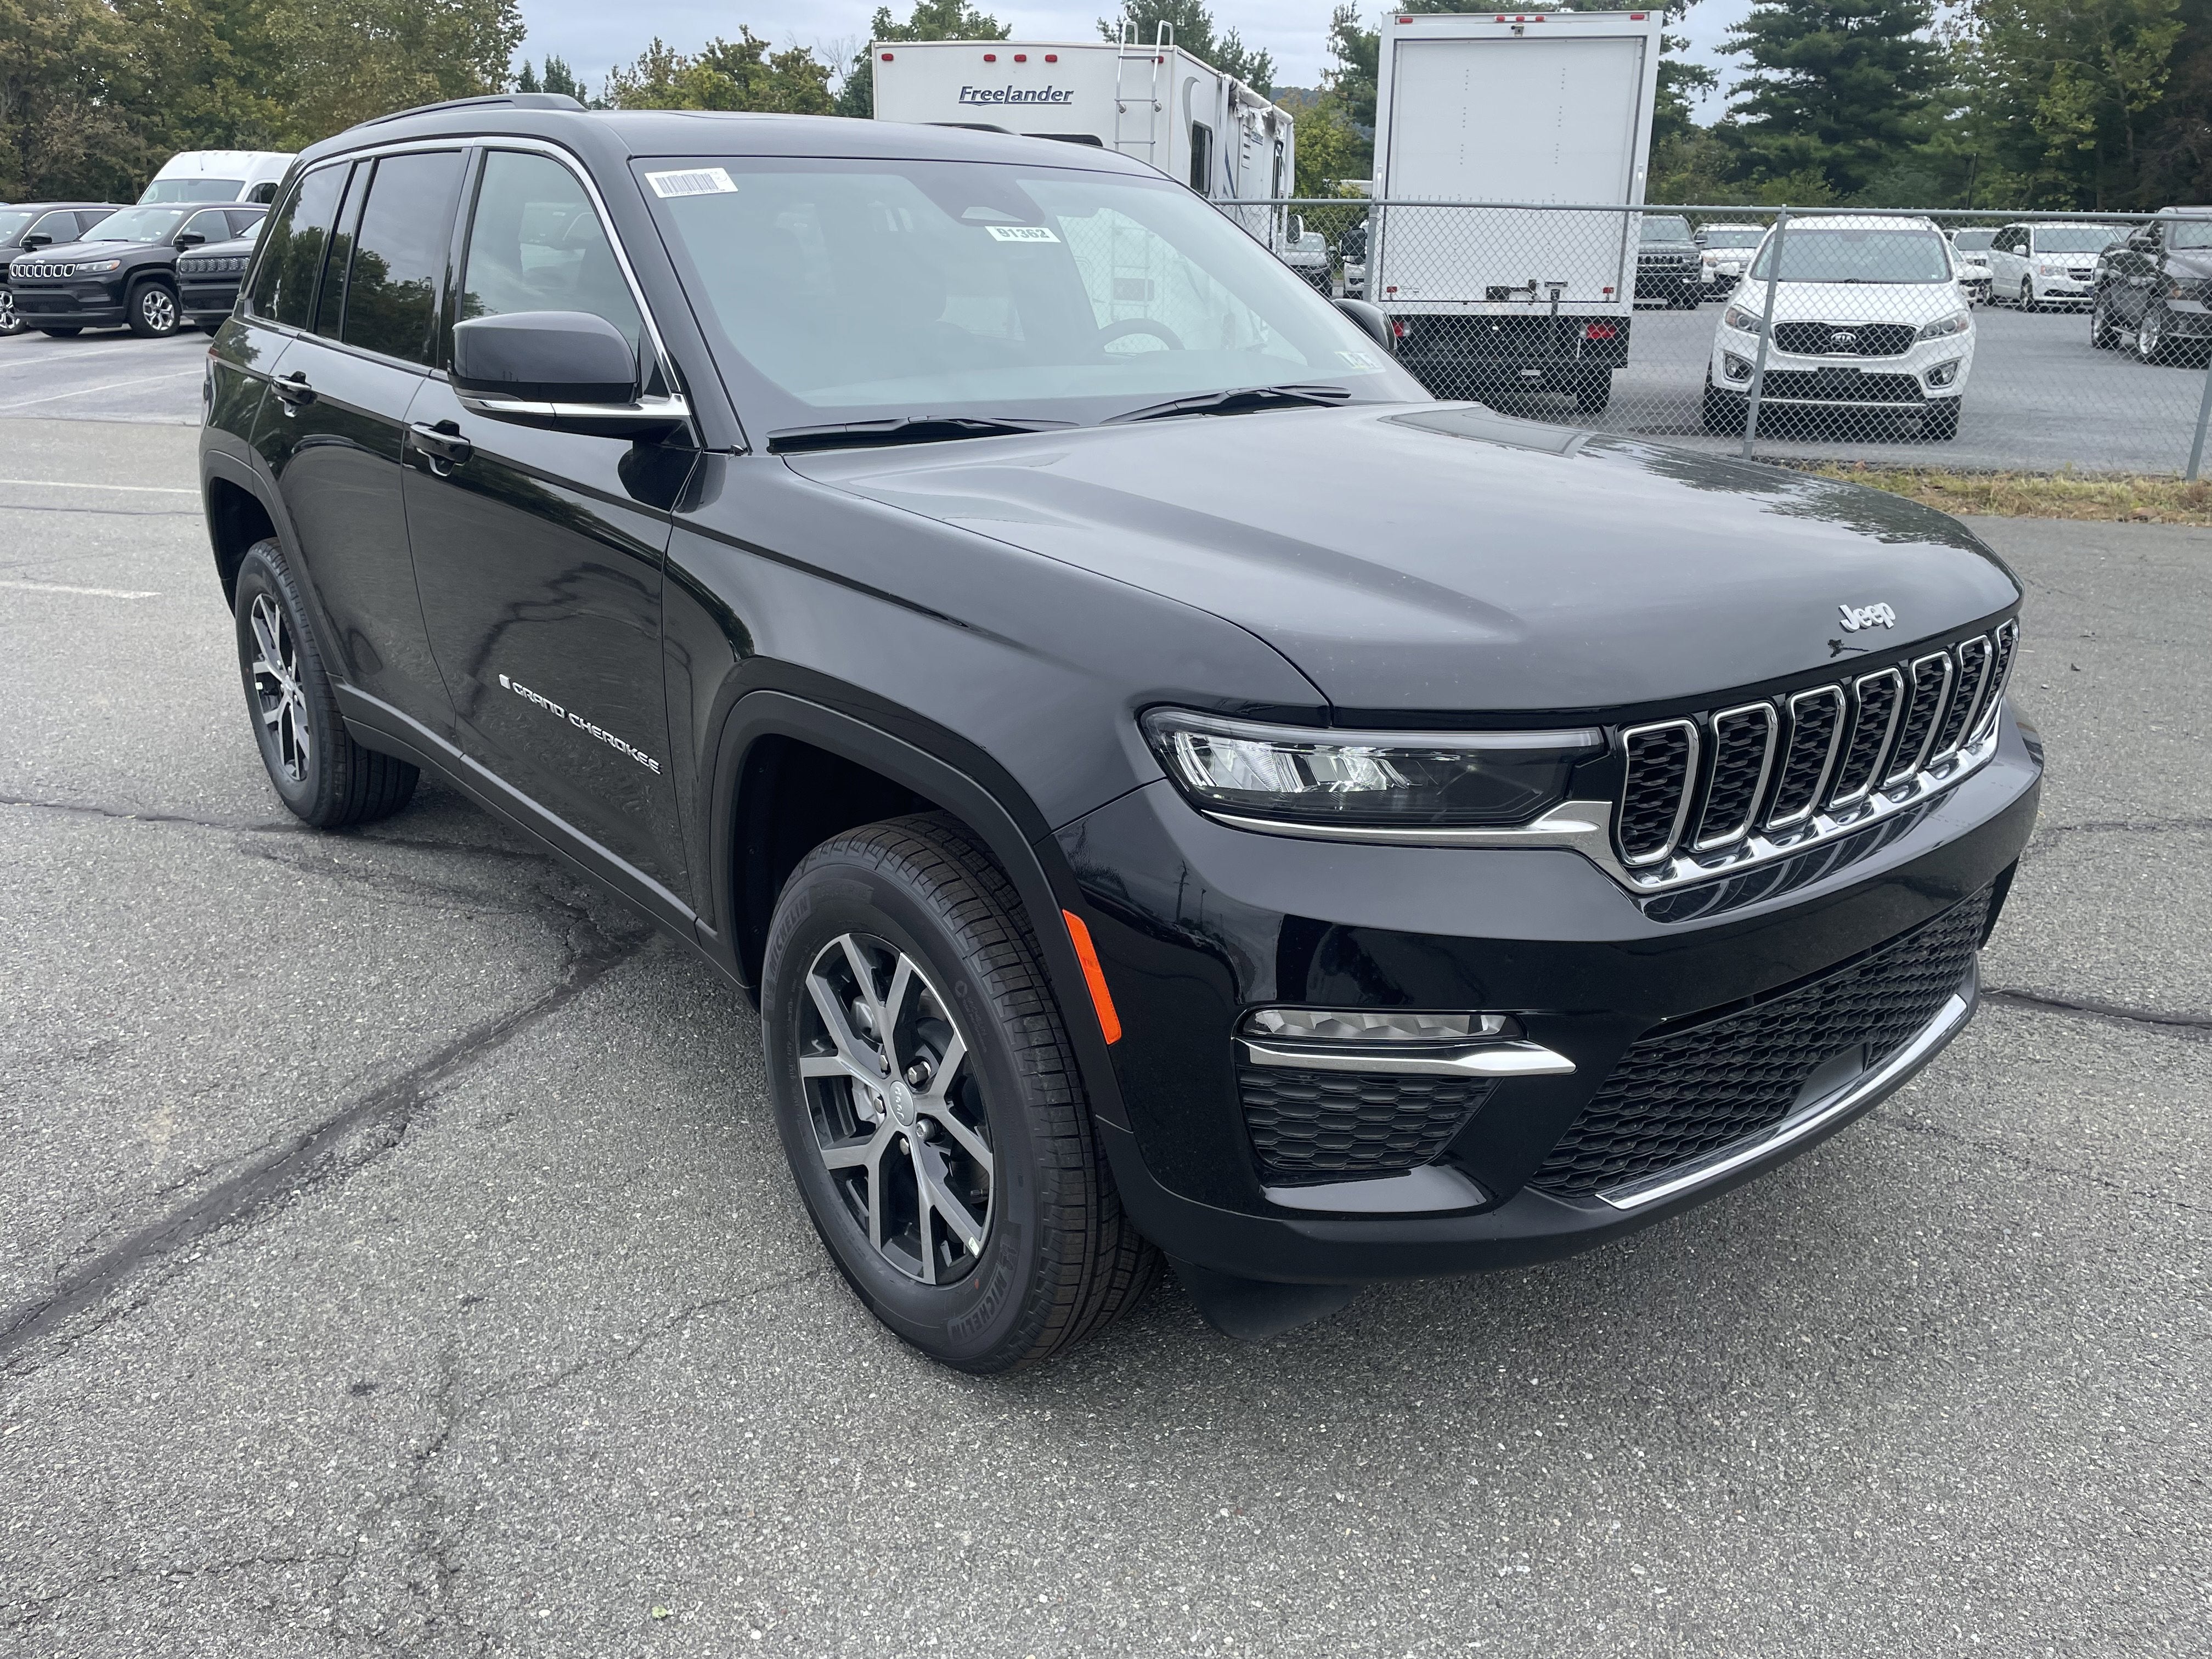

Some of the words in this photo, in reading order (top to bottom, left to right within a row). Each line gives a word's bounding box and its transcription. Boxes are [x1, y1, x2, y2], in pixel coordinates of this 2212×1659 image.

[959, 85, 1074, 105] Freelander
[996, 228, 1050, 239] 91362
[1838, 602, 1896, 633] Jeep
[511, 681, 567, 719] GRAND
[568, 712, 663, 775] CHEROKEE
[769, 894, 811, 978] MICHELIN
[951, 1269, 1007, 1339] MICHELIN
